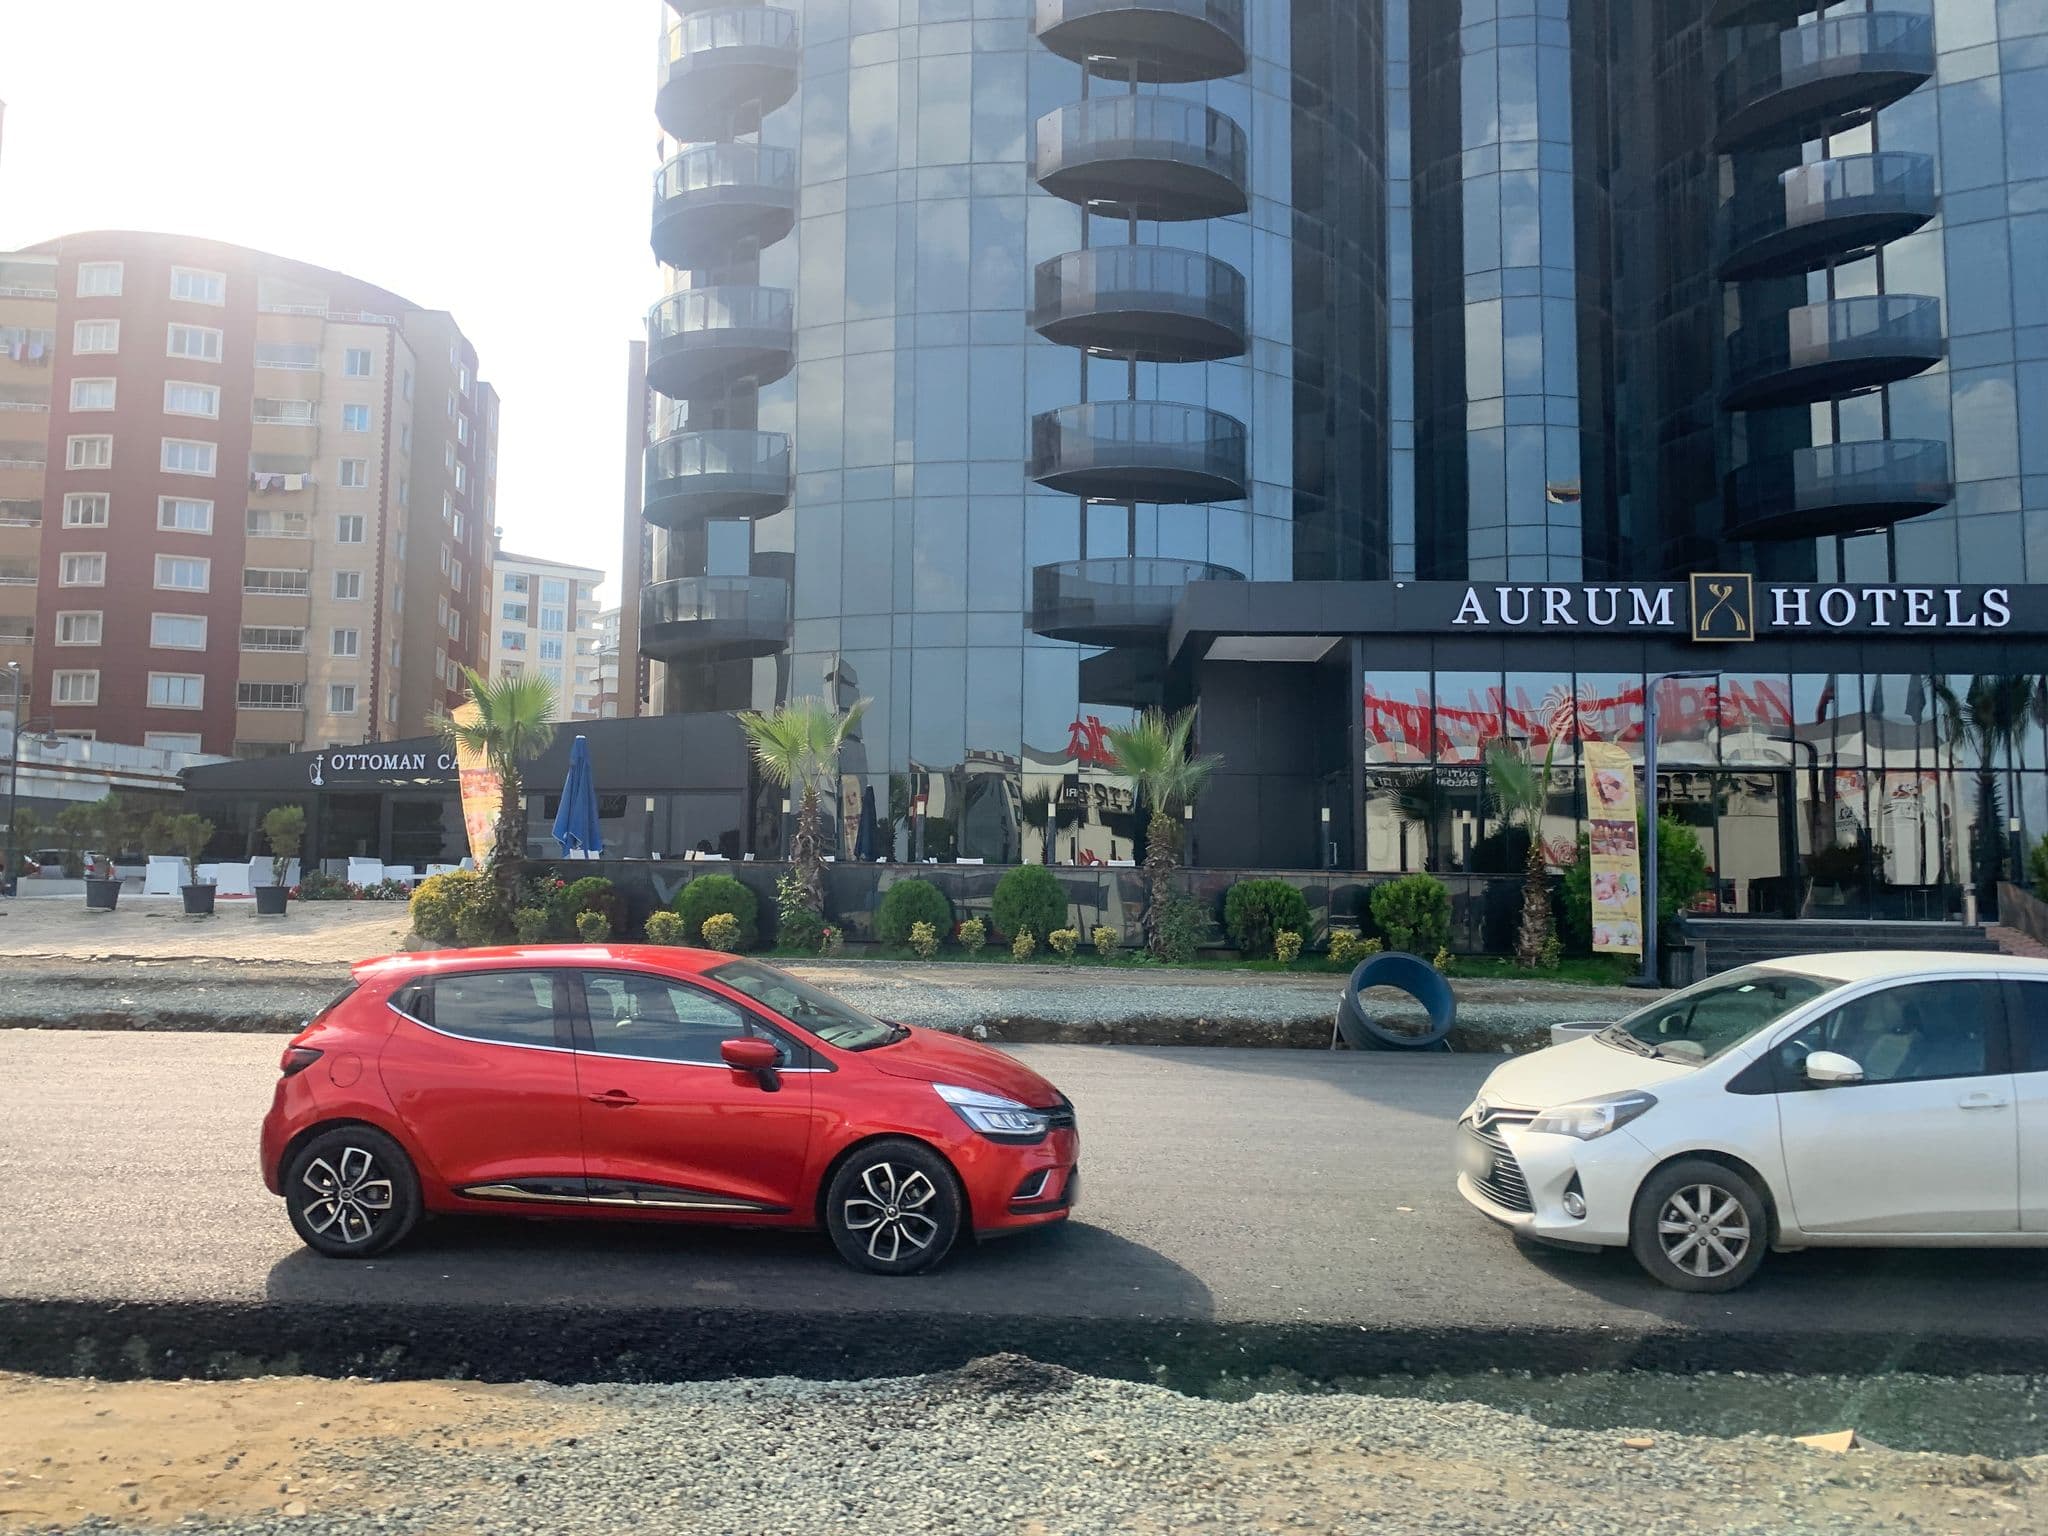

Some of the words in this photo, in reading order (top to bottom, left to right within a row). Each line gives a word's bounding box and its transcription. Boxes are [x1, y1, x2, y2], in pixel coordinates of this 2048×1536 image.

[1451, 586, 1675, 627] AURUM
[1770, 587, 2012, 628] HOTELS
[331, 753, 426, 771] OTTOMAN
